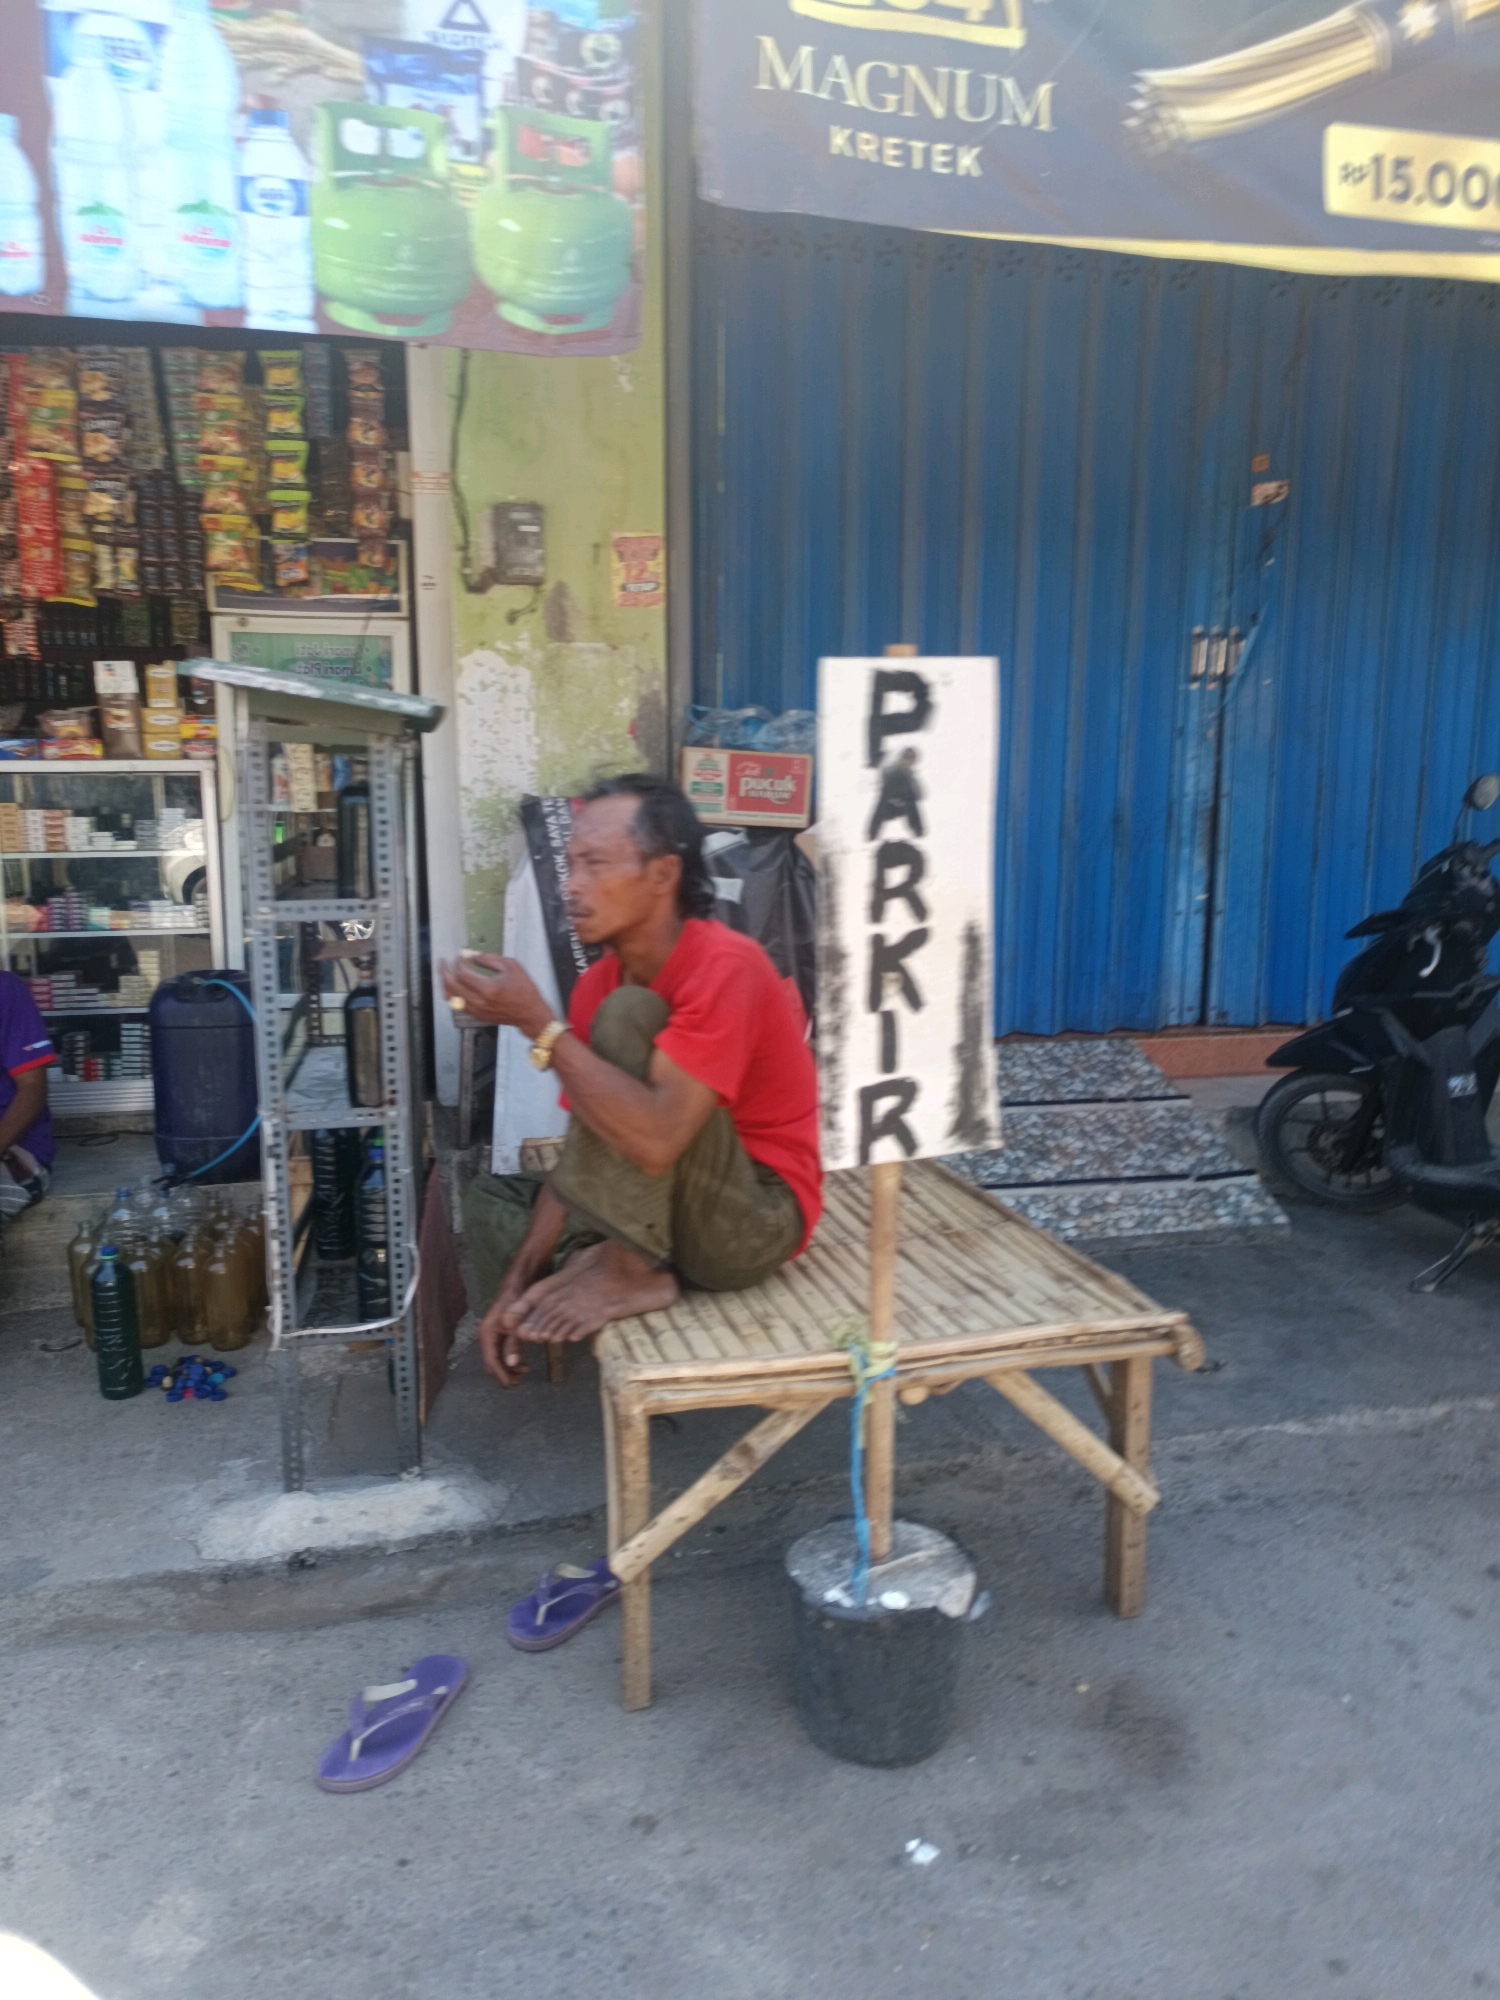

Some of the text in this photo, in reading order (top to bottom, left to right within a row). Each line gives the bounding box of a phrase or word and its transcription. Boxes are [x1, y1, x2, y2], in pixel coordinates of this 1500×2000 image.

[754, 35, 1058, 132] MAGNUM
[829, 124, 984, 178] KRETEK
[857, 666, 936, 1166] PARKIR
